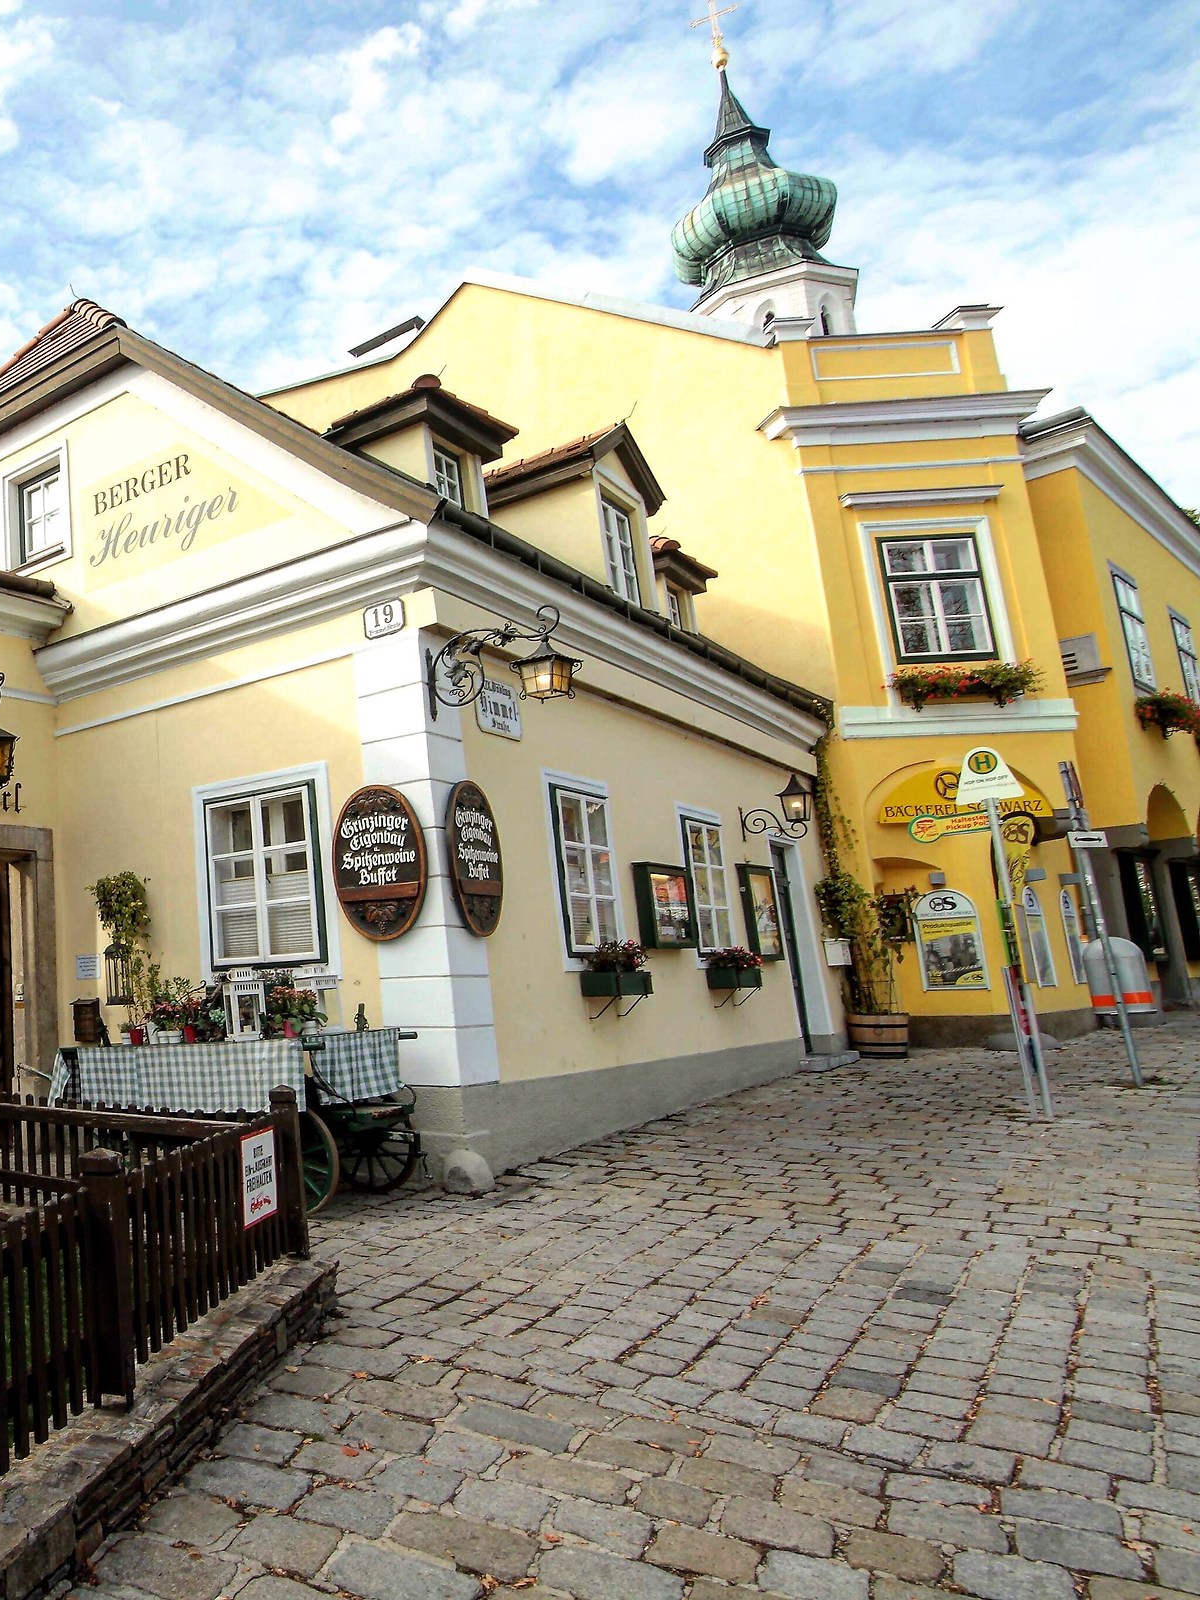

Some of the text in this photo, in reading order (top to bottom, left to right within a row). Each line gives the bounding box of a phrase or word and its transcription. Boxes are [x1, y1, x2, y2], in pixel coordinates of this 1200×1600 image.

[93, 454, 192, 517] BERGER
[89, 486, 240, 568] Heuriger
[372, 604, 394, 628] 19
[974, 754, 992, 771] H
[455, 806, 493, 832] Grinzinger
[884, 799, 1043, 818] BÄCKEREI SCWARZ
[340, 811, 409, 839] Grinzinger
[460, 825, 492, 847] Eigenbau
[945, 822, 972, 831] Pickup
[349, 830, 407, 851] Eigenbau
[341, 847, 416, 871] Spitzenweine
[457, 842, 499, 864] Spitzenweine
[358, 866, 398, 886] Buffet
[468, 861, 490, 881] Buffet
